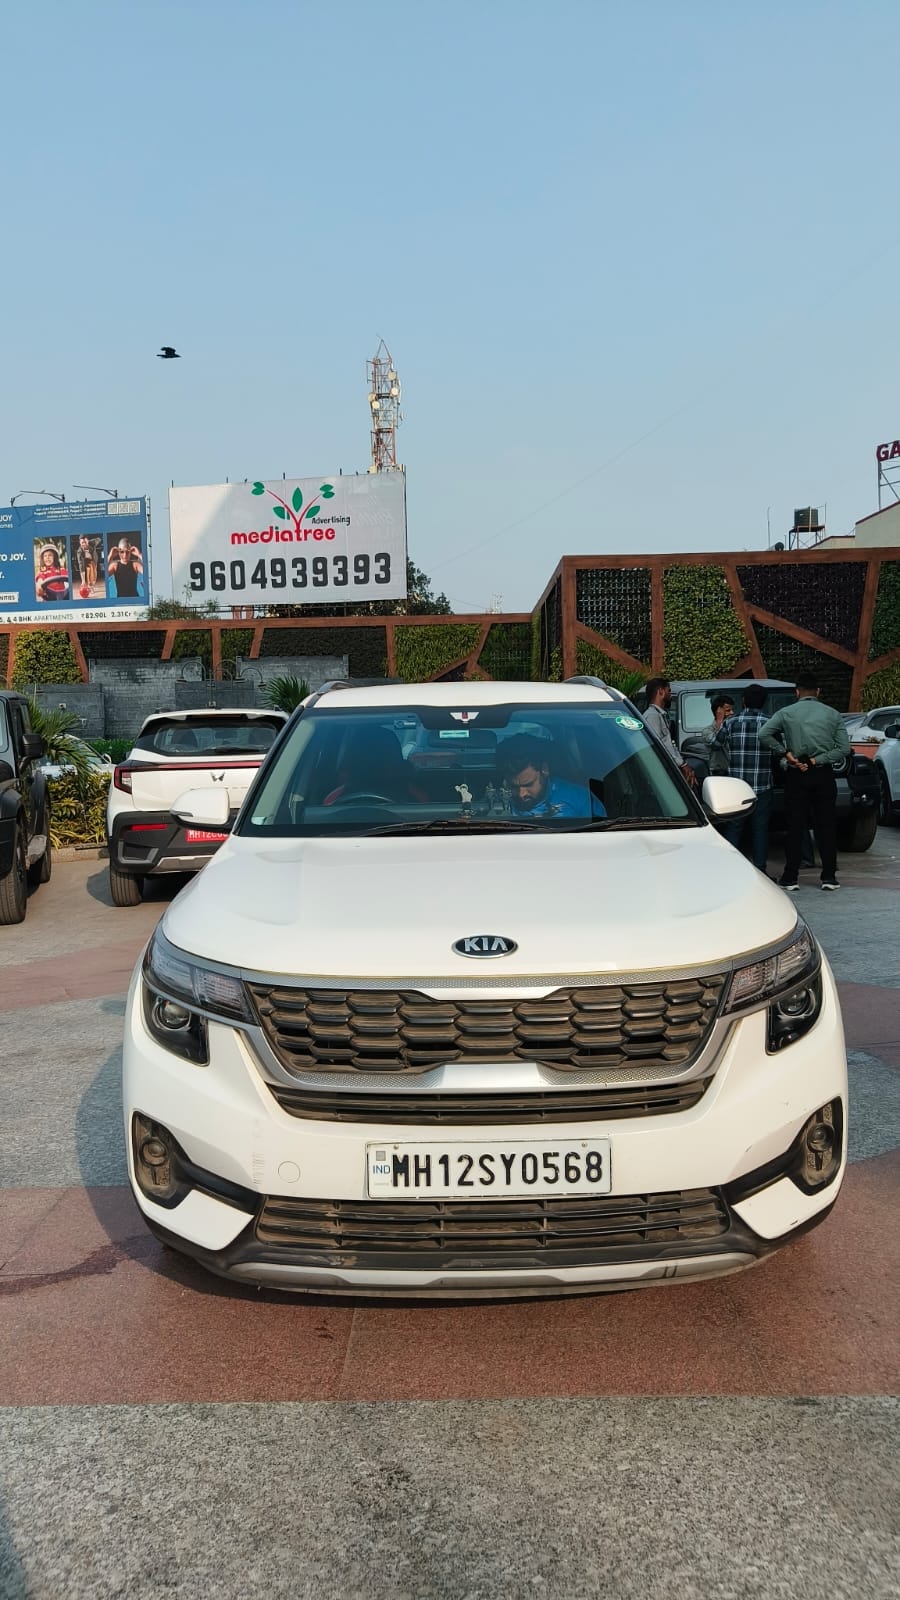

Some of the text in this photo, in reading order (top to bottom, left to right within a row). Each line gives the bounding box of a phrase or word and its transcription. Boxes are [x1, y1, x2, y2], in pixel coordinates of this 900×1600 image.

[311, 515, 350, 526] Advertising
[231, 526, 336, 545] mediatree
[10, 552, 27, 561] JOY.
[190, 553, 391, 591] 9604939393
[464, 937, 508, 952] KIA
[373, 1151, 603, 1187] IND MH12SY0568
